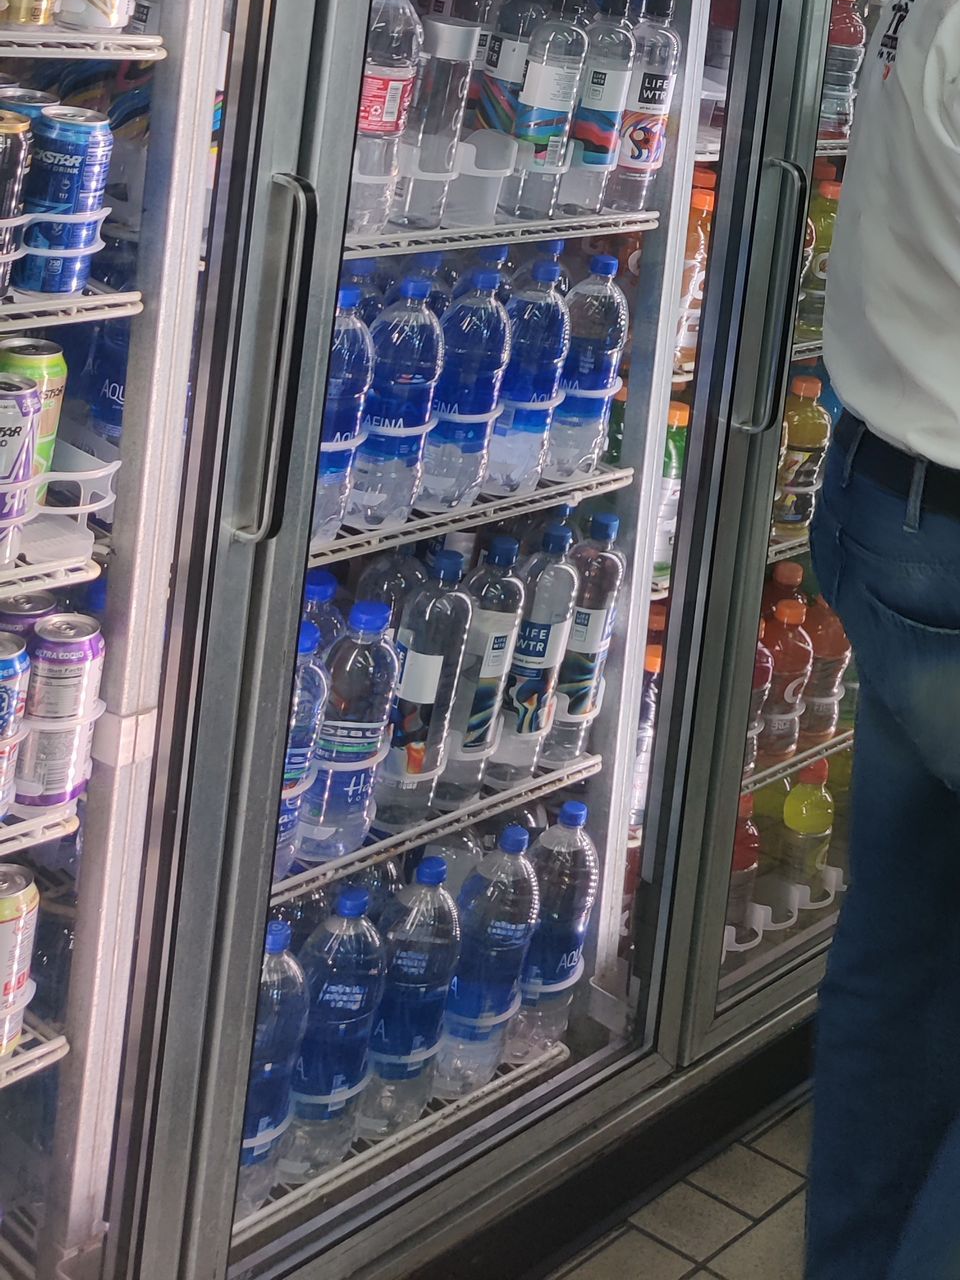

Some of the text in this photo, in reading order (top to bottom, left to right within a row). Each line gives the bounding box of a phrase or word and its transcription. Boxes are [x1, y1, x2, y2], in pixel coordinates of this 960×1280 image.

[644, 78, 670, 90] LIFE
[642, 88, 668, 101] WTR
[52, 166, 80, 175] DRINK
[515, 638, 546, 653] WTR
